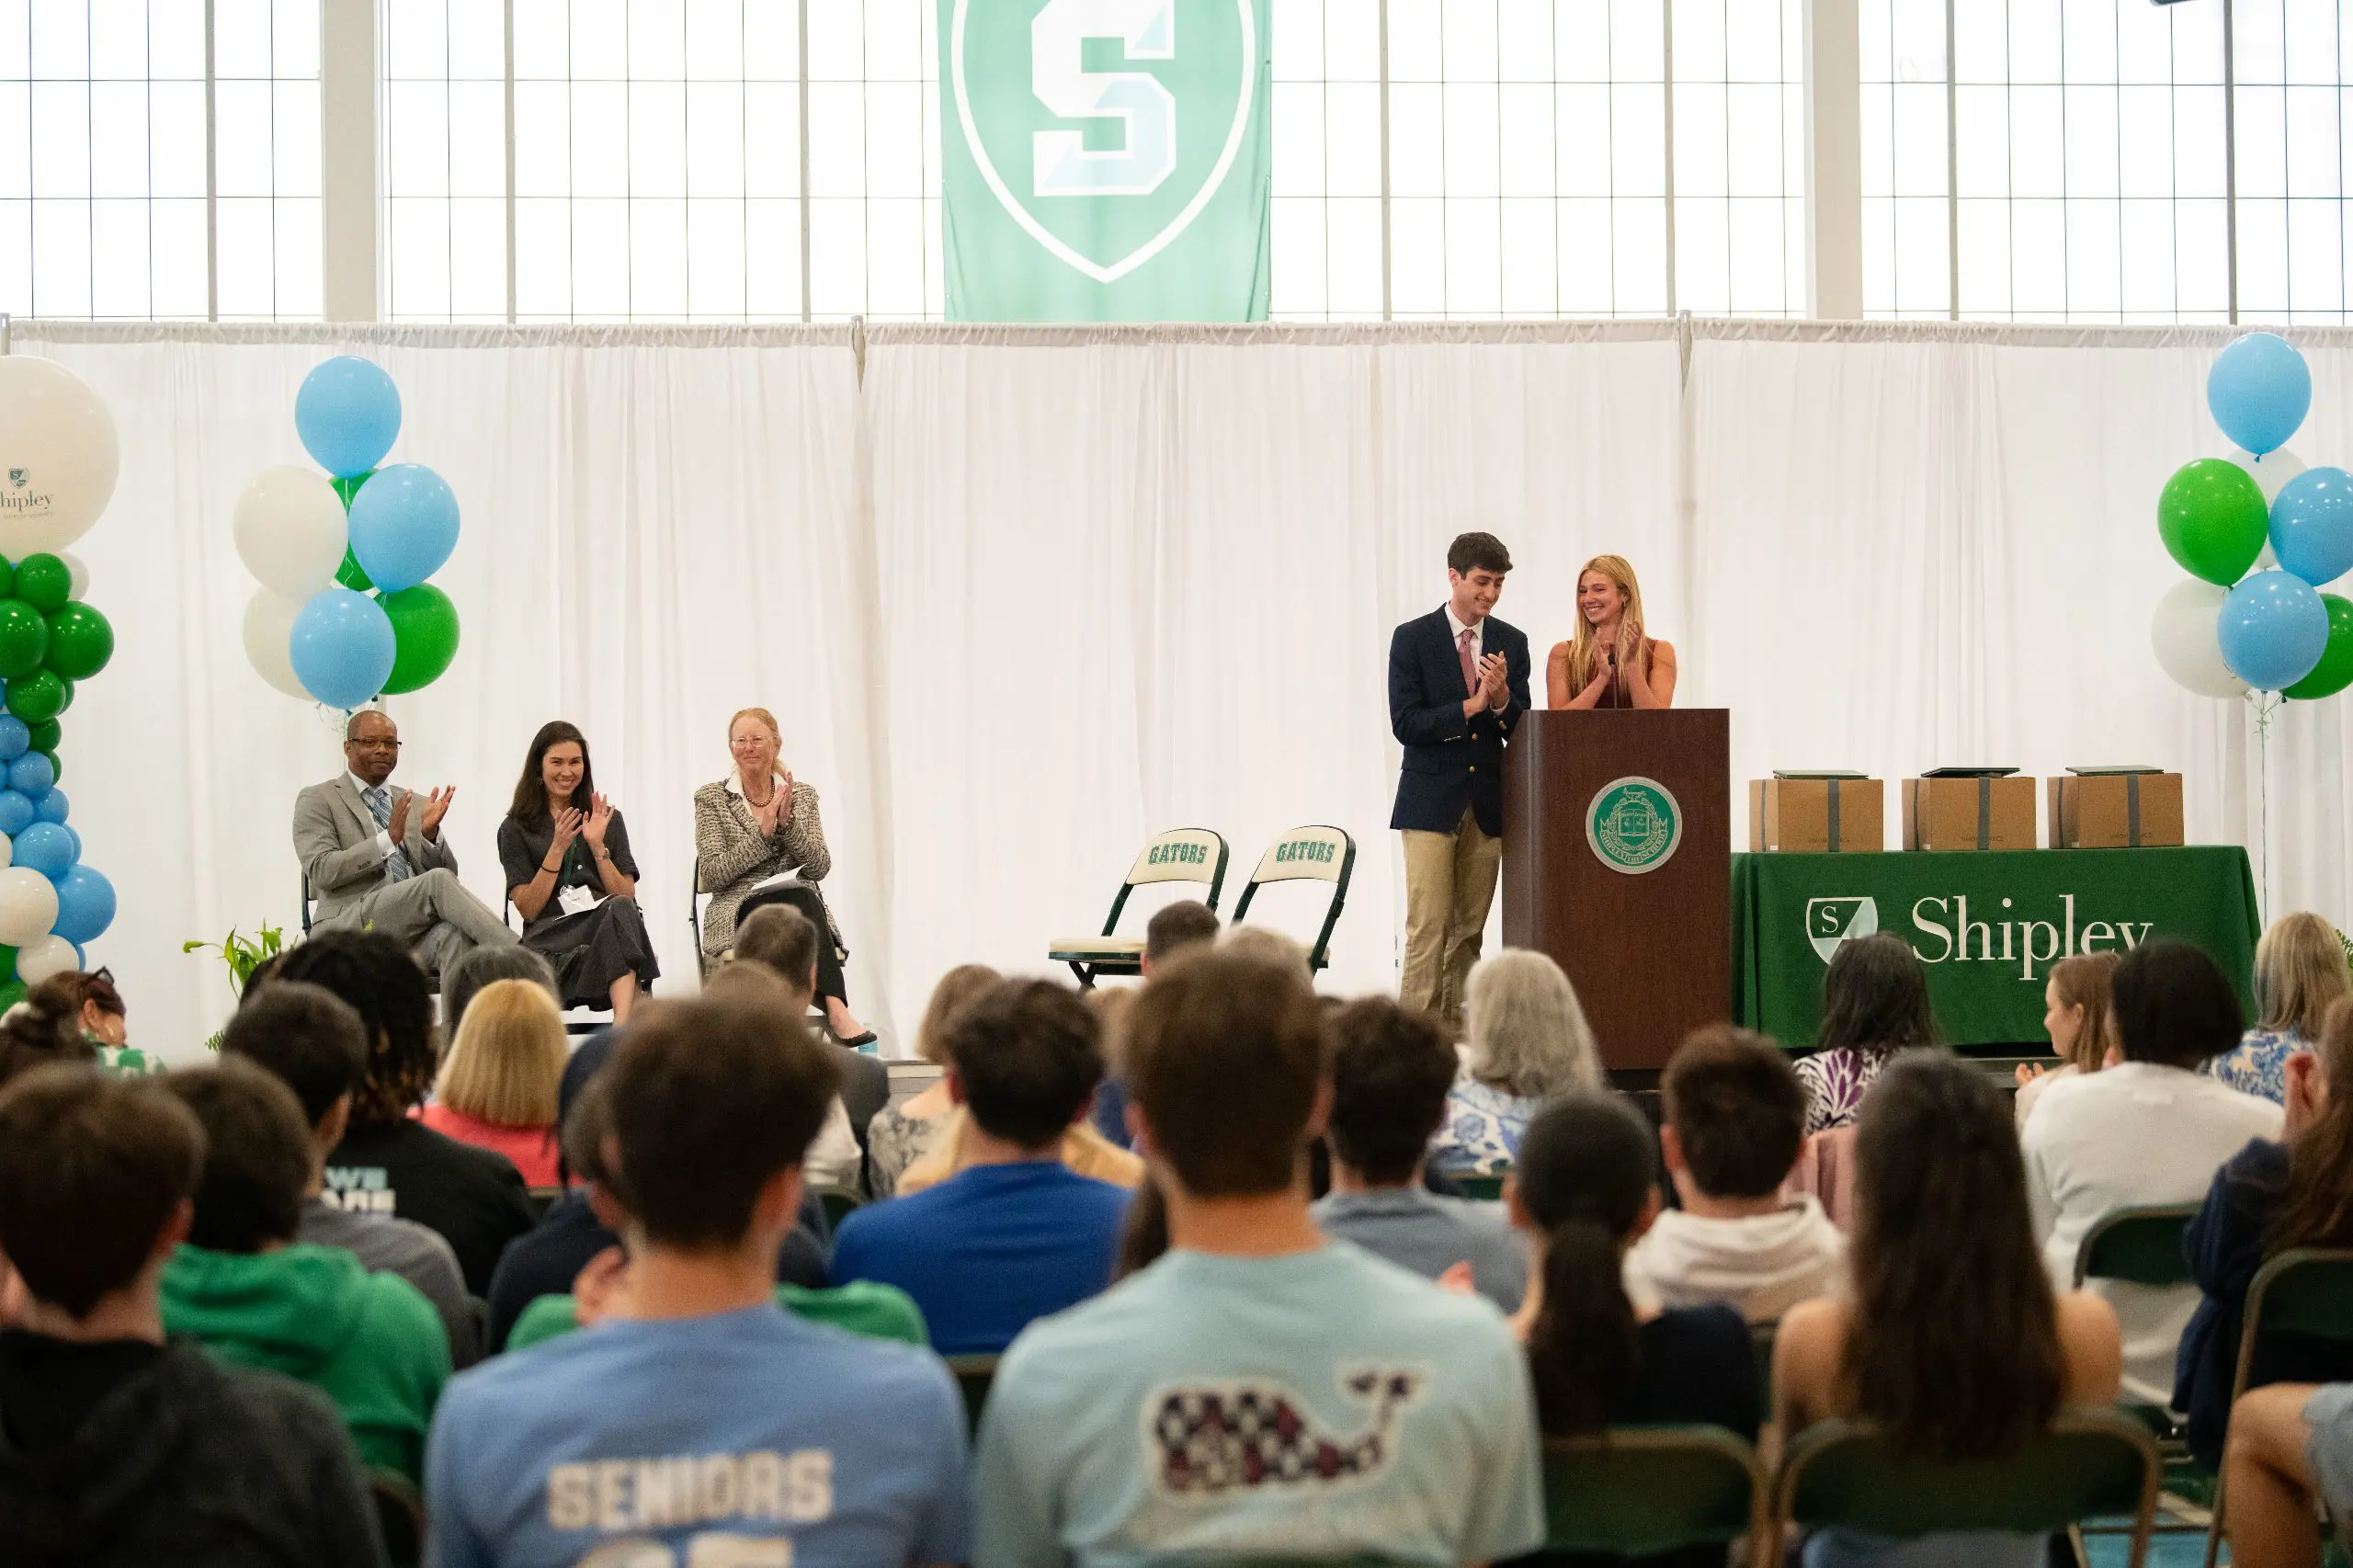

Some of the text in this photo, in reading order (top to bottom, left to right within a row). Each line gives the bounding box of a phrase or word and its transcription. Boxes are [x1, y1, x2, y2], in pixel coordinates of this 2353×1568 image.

[1031, 0, 1176, 196] S
[0, 490, 55, 512] hipley
[1148, 842, 1208, 865] GATORS
[1276, 840, 1336, 863] GATORS
[549, 1450, 834, 1528] SENIORS
